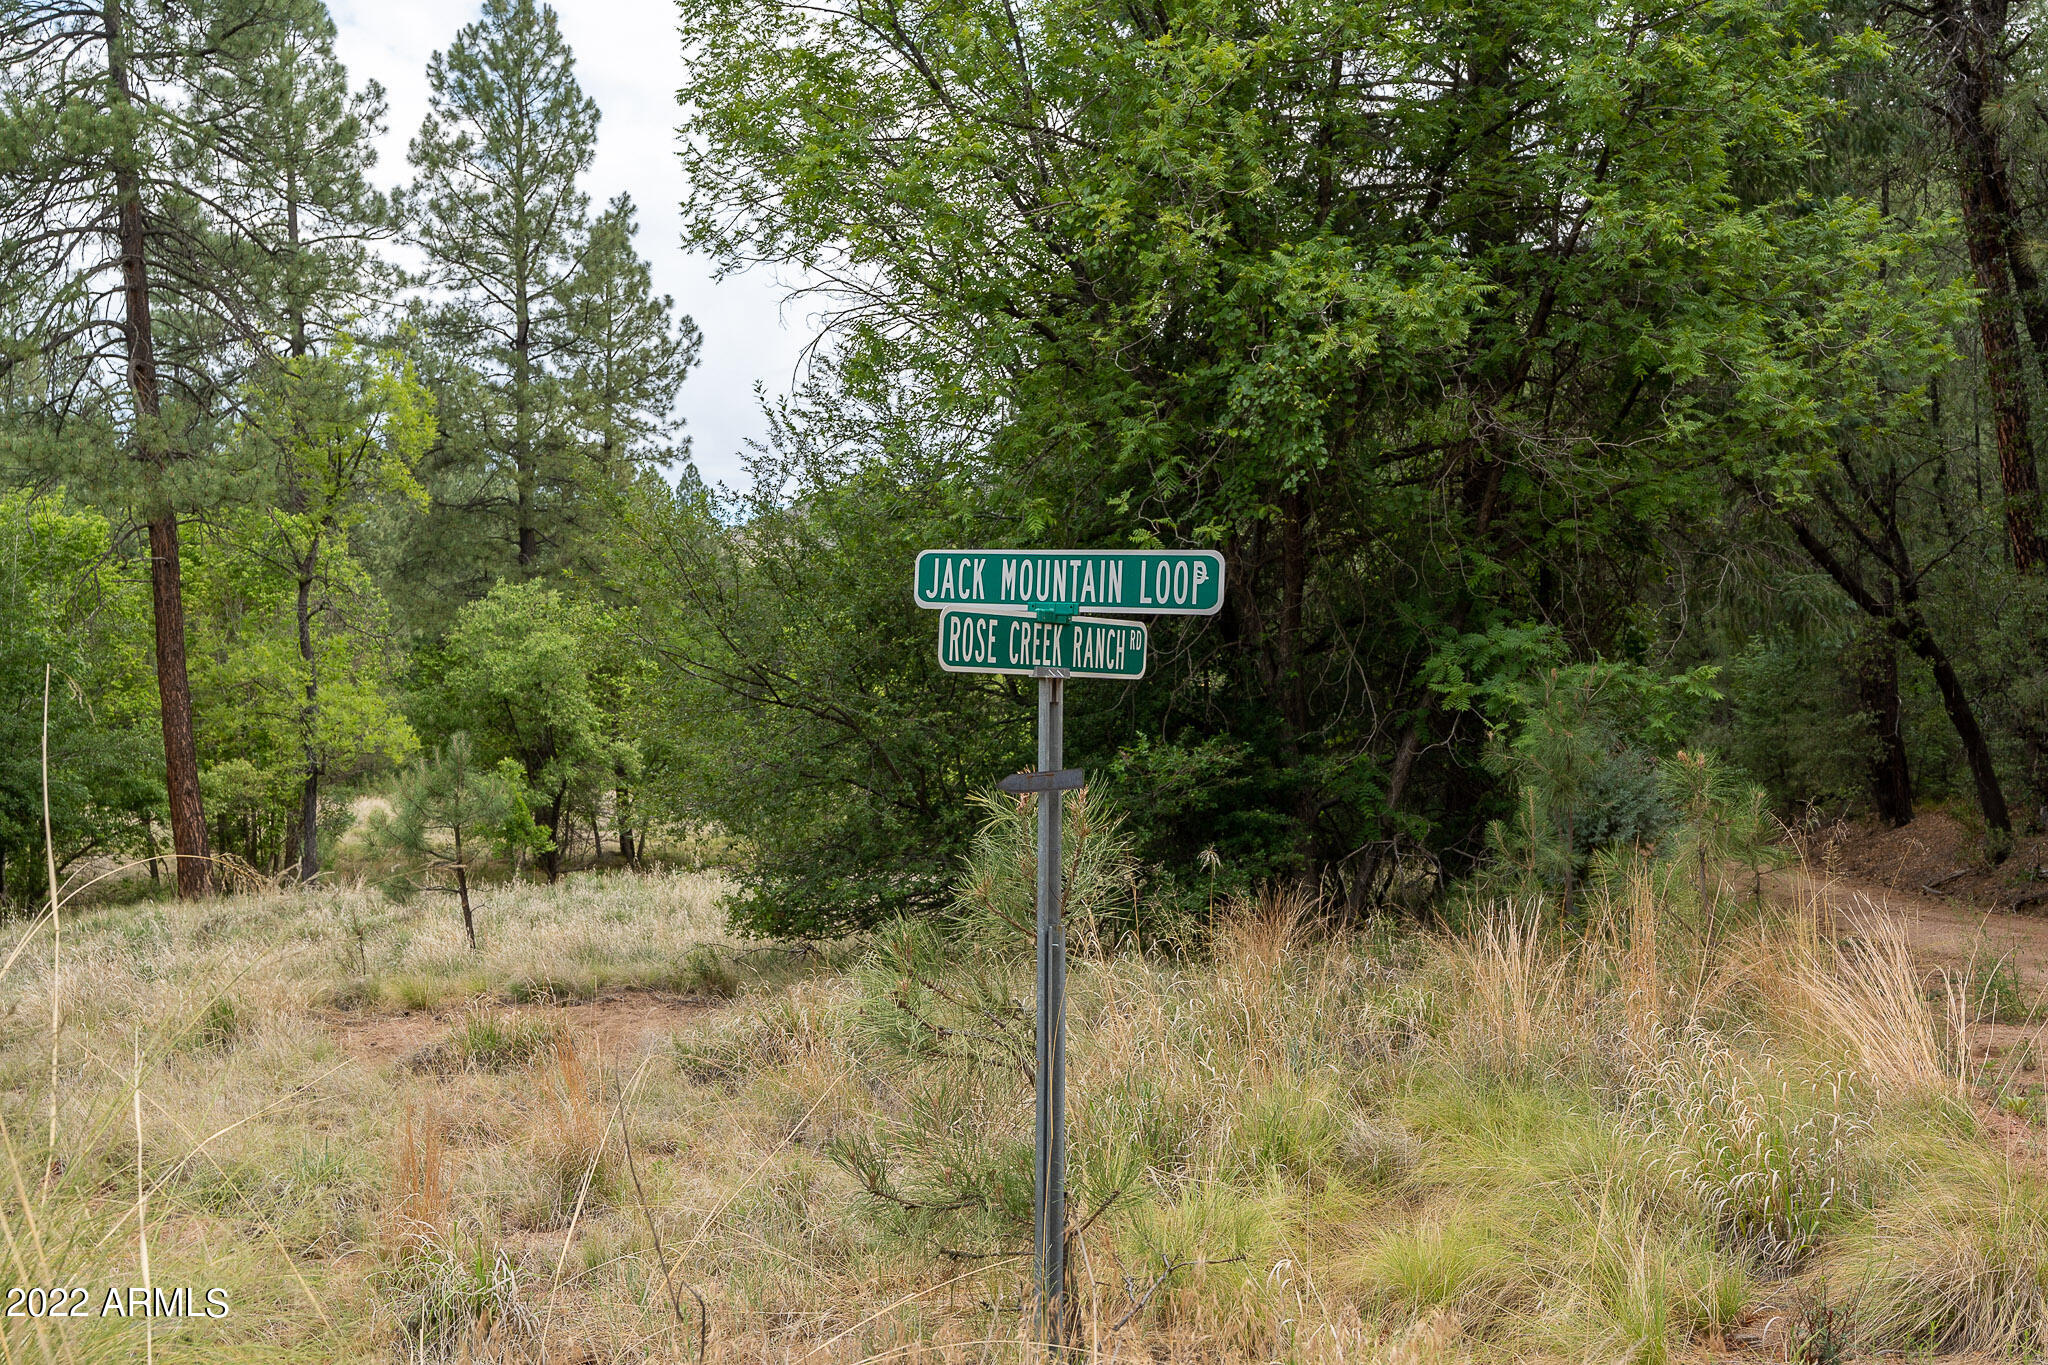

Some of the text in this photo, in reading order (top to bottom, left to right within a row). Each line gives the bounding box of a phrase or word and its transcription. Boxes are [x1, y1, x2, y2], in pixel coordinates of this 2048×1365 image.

[925, 557, 1209, 605] JACK MOUNTAIN LOOP
[948, 616, 1142, 670] ROSE CREEK RANCH RD
